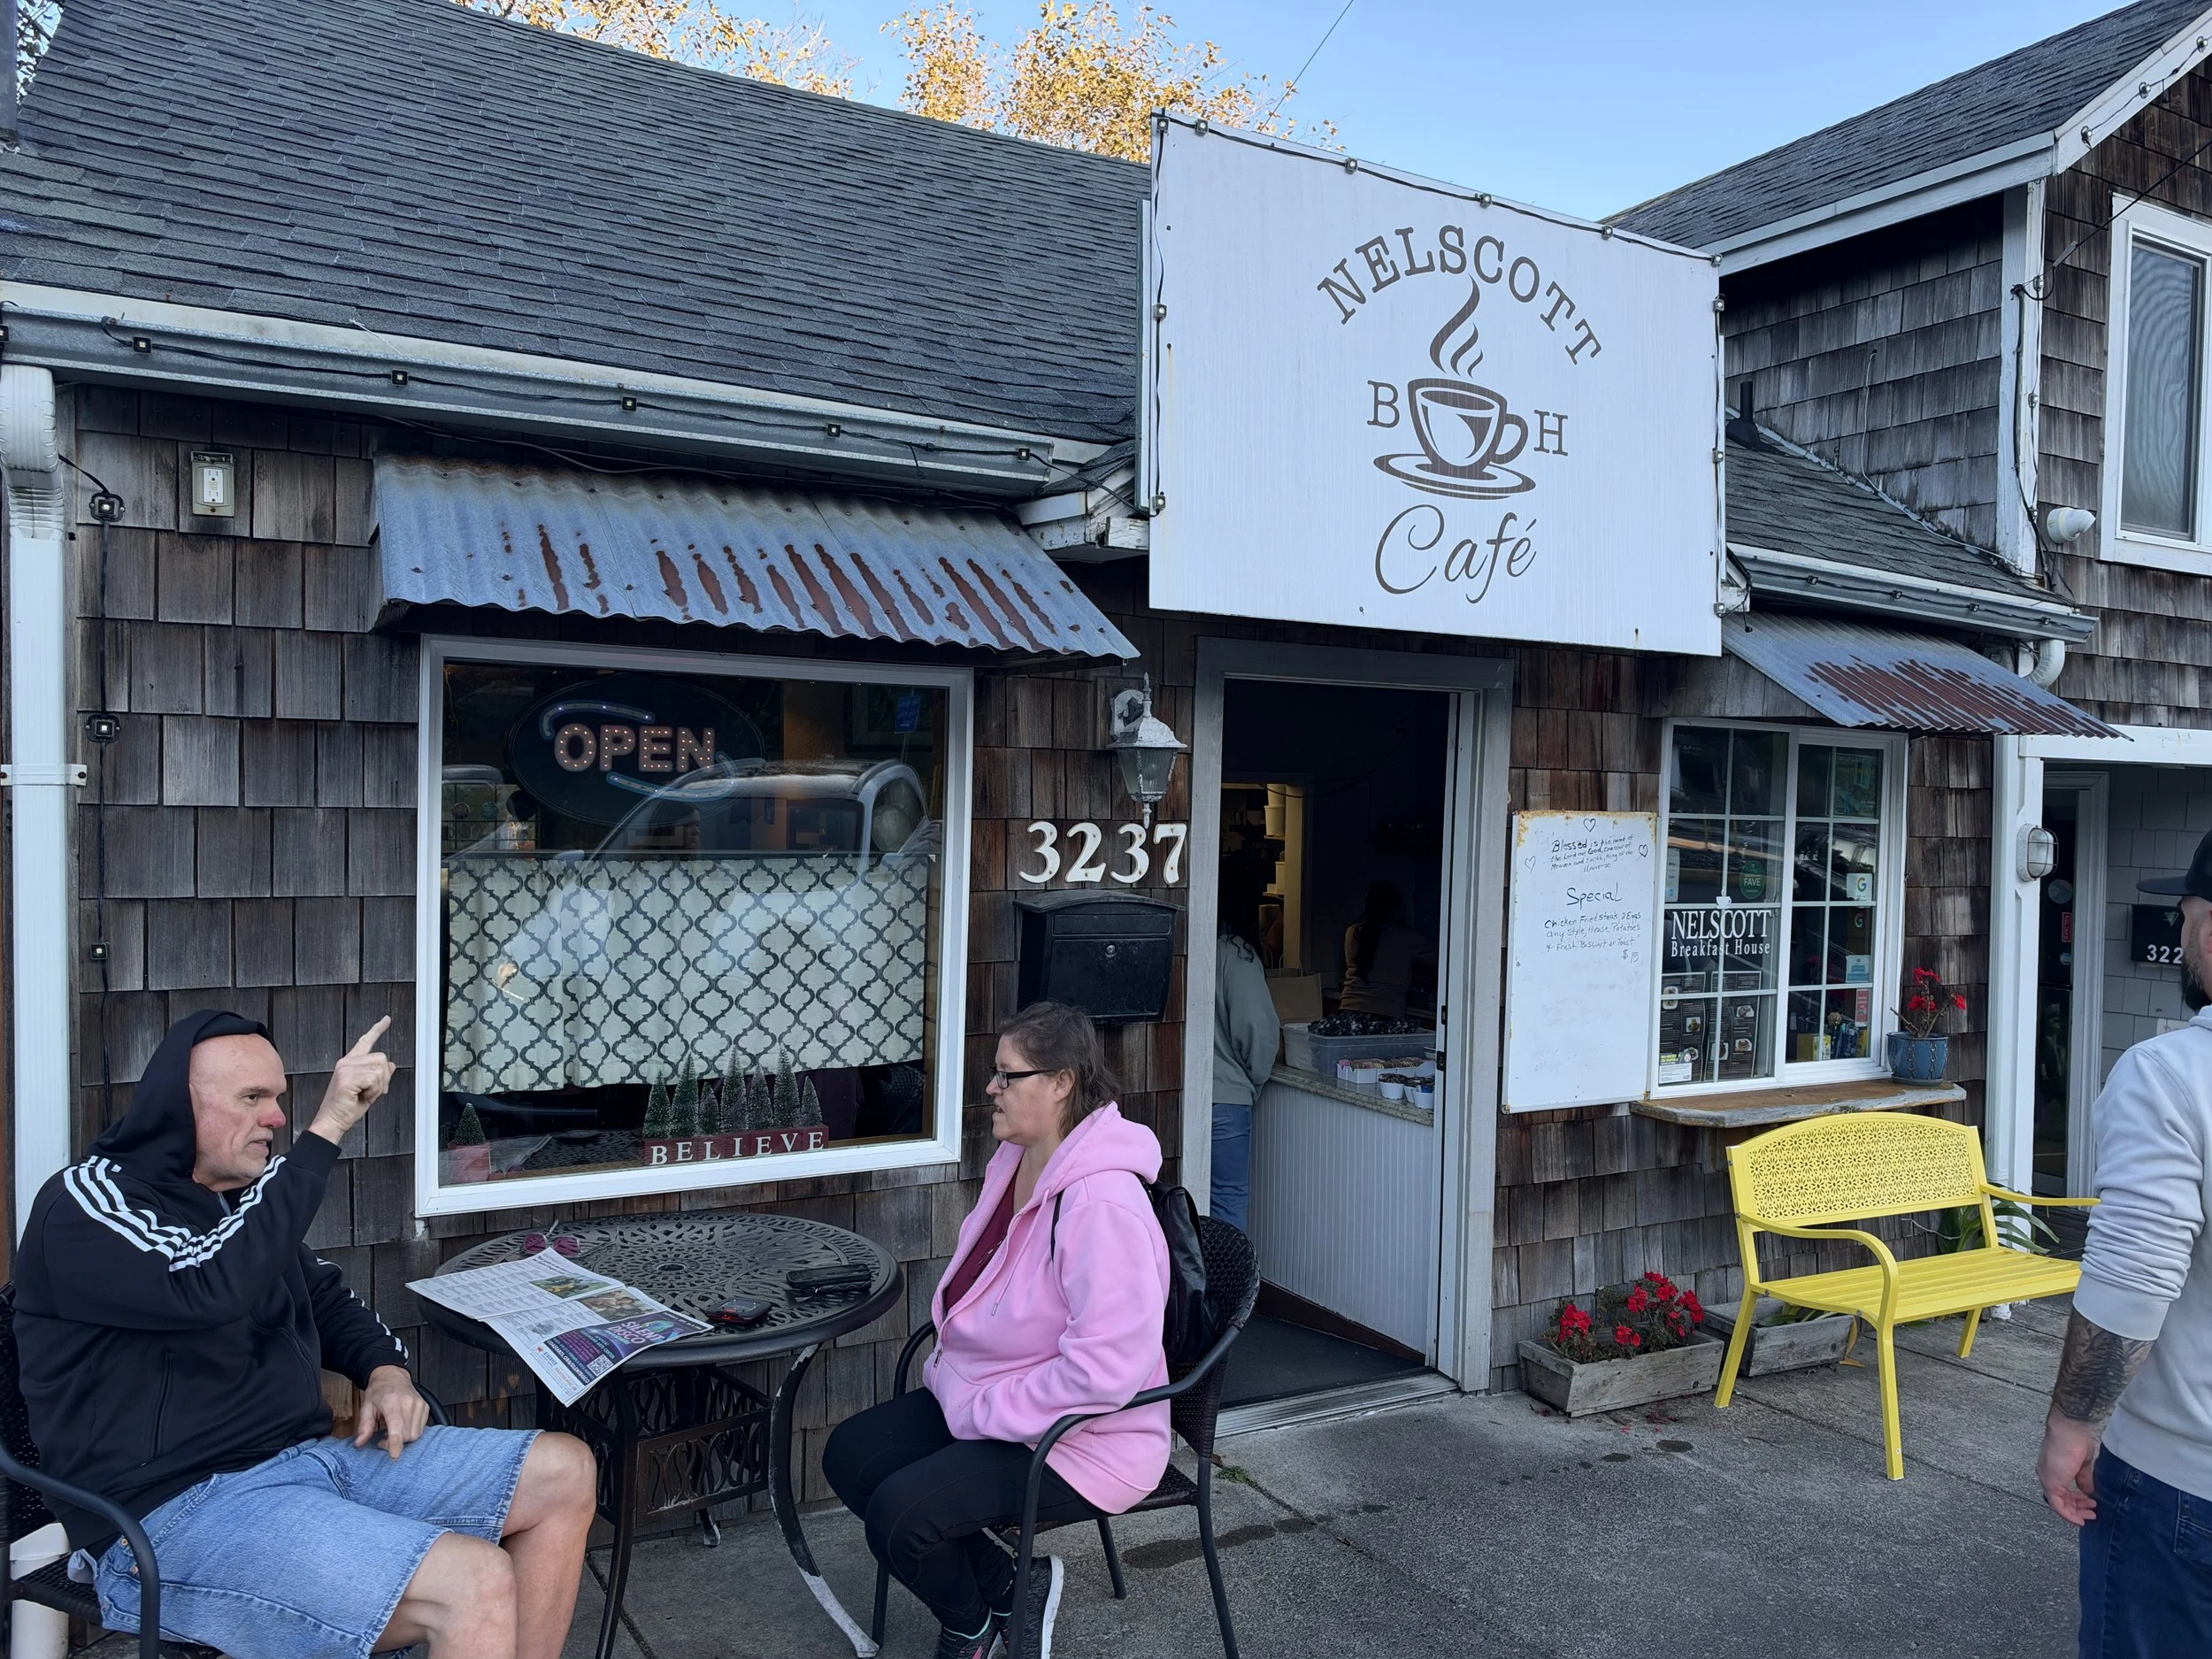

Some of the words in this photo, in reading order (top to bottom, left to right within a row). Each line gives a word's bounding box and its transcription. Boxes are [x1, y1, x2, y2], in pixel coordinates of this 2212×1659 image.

[1317, 225, 1601, 365] NELSCOTT
[1367, 380, 1401, 428] B
[1533, 410, 1569, 457] H
[1375, 504, 1537, 603] Café
[554, 723, 715, 772] OPEN
[1018, 821, 1187, 884] 3237
[1551, 839, 1587, 853] Blessed
[1744, 877, 1761, 887] FAVE
[1566, 882, 1622, 910] Special
[1544, 917, 1577, 929] Chicken
[1579, 913, 1598, 924] Fried
[1611, 923, 1641, 933] Potatoes
[1671, 910, 1772, 940] NELSCOTT
[1556, 941, 1578, 951] Fresh
[1580, 938, 1606, 948] Biscuit
[1617, 937, 1635, 947] Toast
[1671, 939, 1729, 957] Breakfast
[1734, 939, 1770, 955] House
[649, 1132, 824, 1165] BELIEVE
[608, 1325, 646, 1344] DISCO
[621, 1321, 665, 1342] SILENT
